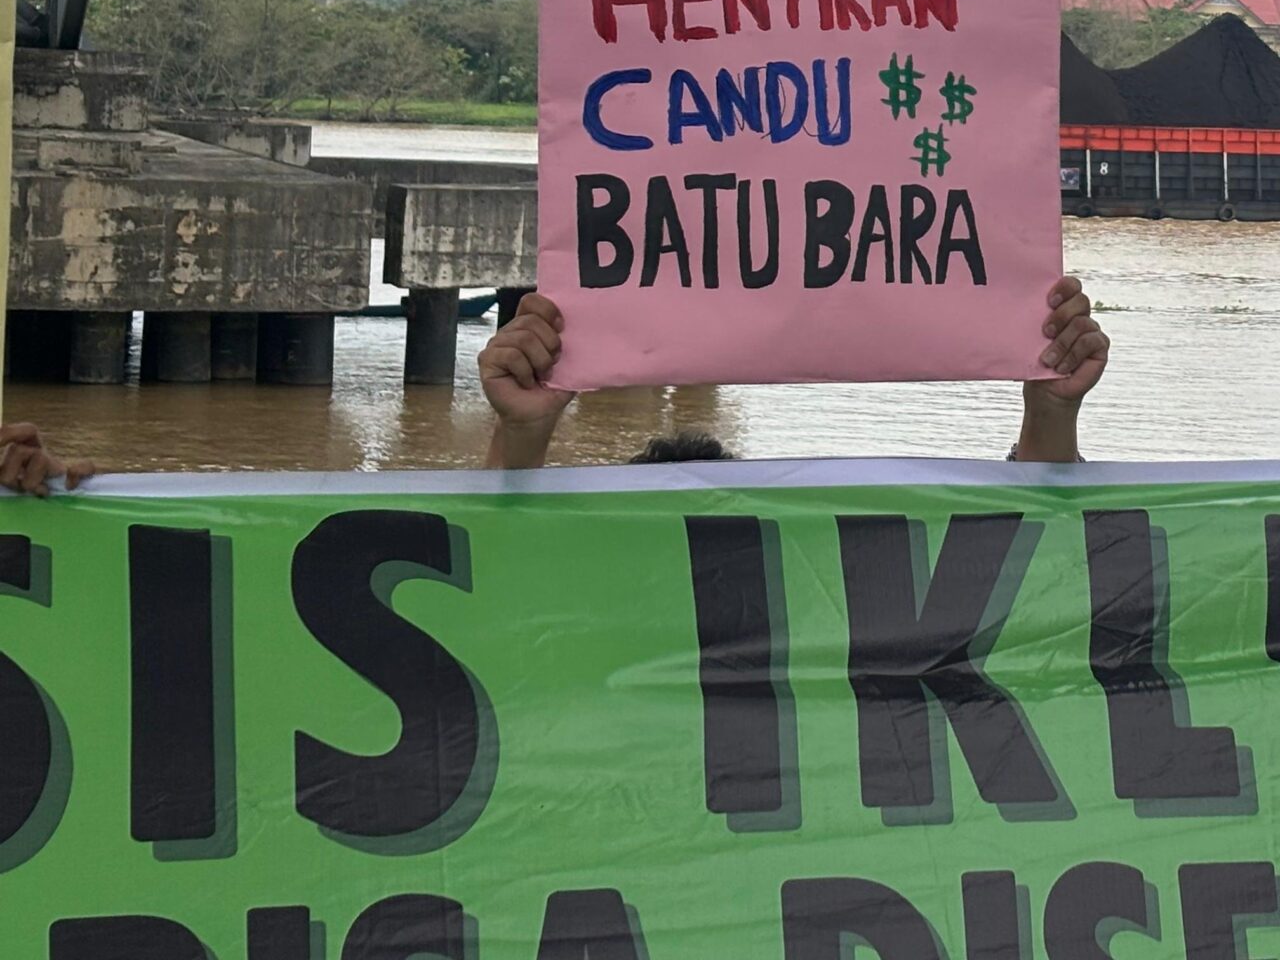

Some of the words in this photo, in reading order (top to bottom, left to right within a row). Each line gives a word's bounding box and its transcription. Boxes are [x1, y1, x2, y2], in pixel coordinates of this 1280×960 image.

[582, 57, 852, 150] CANDU
[1100, 161, 1109, 176] 8
[576, 174, 780, 289] BATU
[803, 179, 987, 289] BARA
[0, 509, 490, 852] IS
